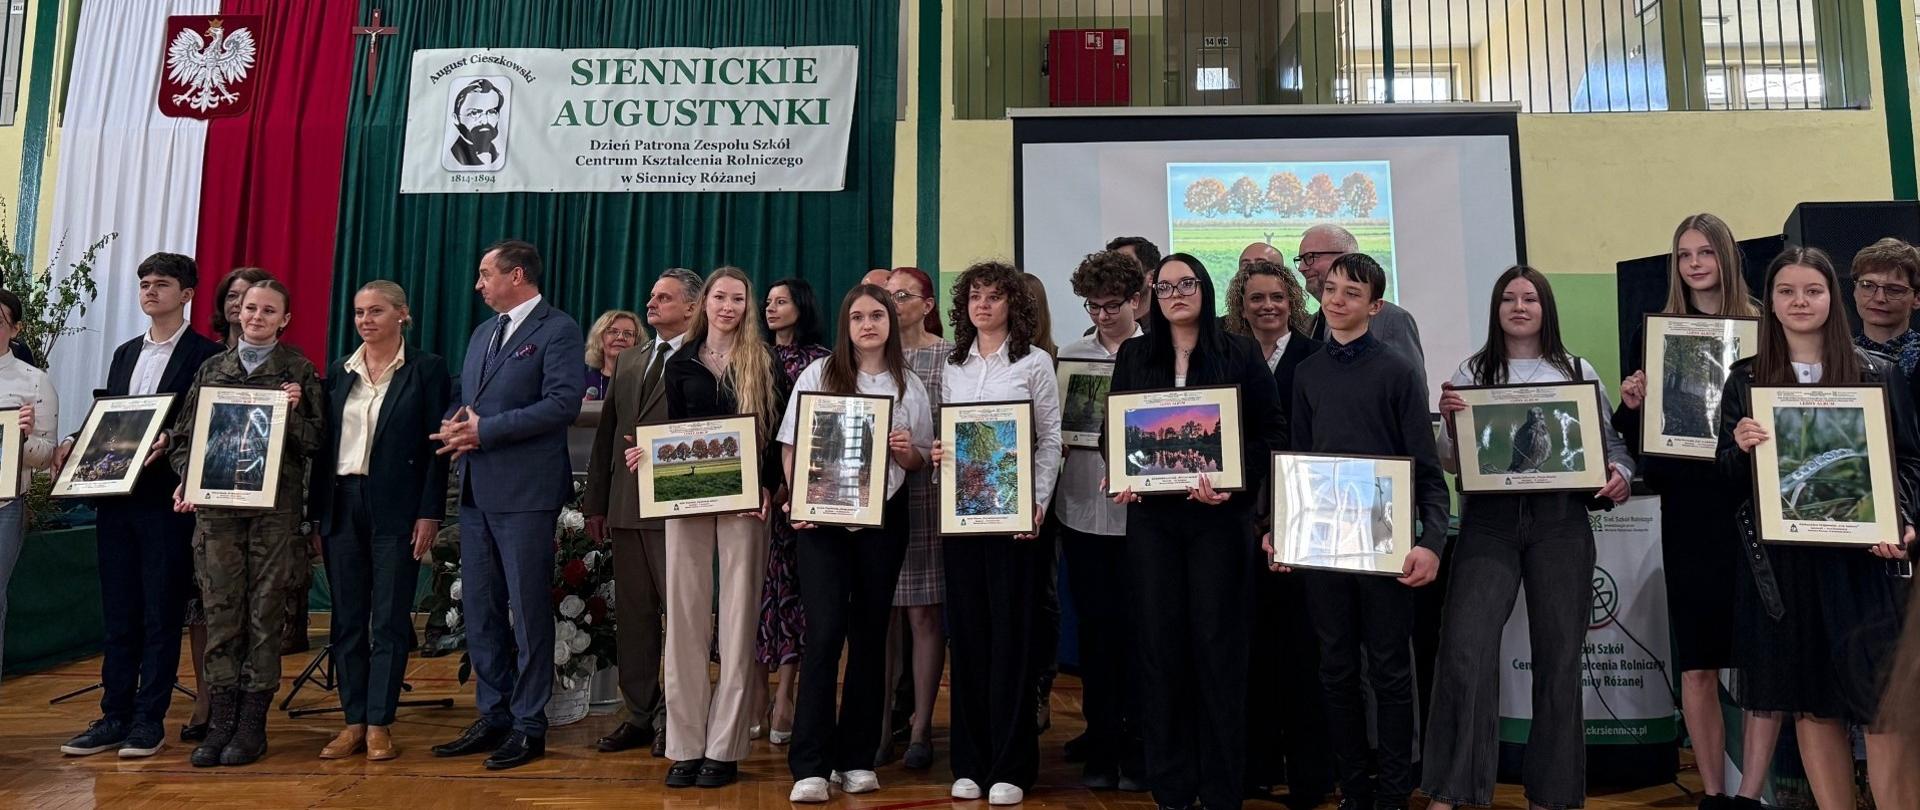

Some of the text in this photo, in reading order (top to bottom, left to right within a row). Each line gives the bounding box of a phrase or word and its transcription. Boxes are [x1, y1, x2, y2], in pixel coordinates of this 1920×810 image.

[429, 54, 536, 84] August Cieszkowski
[570, 57, 818, 86] SIENNICKIE
[551, 98, 831, 127] AUGUSTYNKI
[590, 138, 790, 153] Dzień Patrona Zespołu Szkół
[575, 155, 803, 169] Centrum Kształcenia Rolniczego
[451, 175, 496, 184] 1814-1894
[621, 172, 756, 186] w Siennicy Różanej
[1598, 643, 1624, 655] Szkół
[1604, 675, 1643, 689] Różanej
